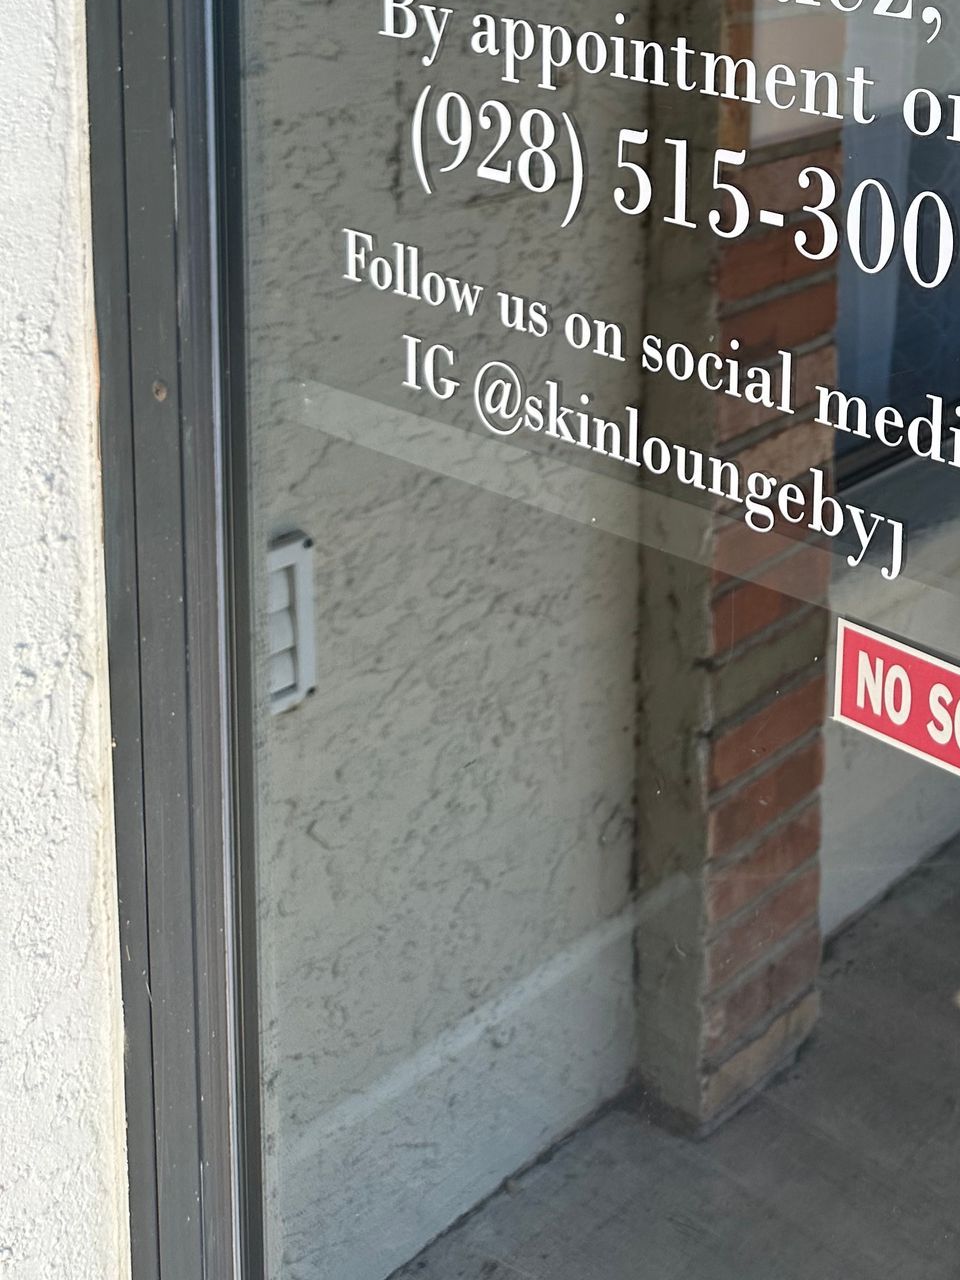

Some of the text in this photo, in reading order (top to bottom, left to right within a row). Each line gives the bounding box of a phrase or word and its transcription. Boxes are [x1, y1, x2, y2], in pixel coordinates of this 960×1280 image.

[471, 12, 876, 124] appointment
[411, 85, 584, 228] (928)
[342, 228, 484, 316] Follow
[497, 291, 549, 337] us
[564, 313, 626, 362] on
[642, 334, 795, 414] social
[402, 334, 906, 581] IG @skinloungebyj
[856, 650, 912, 726] NO
